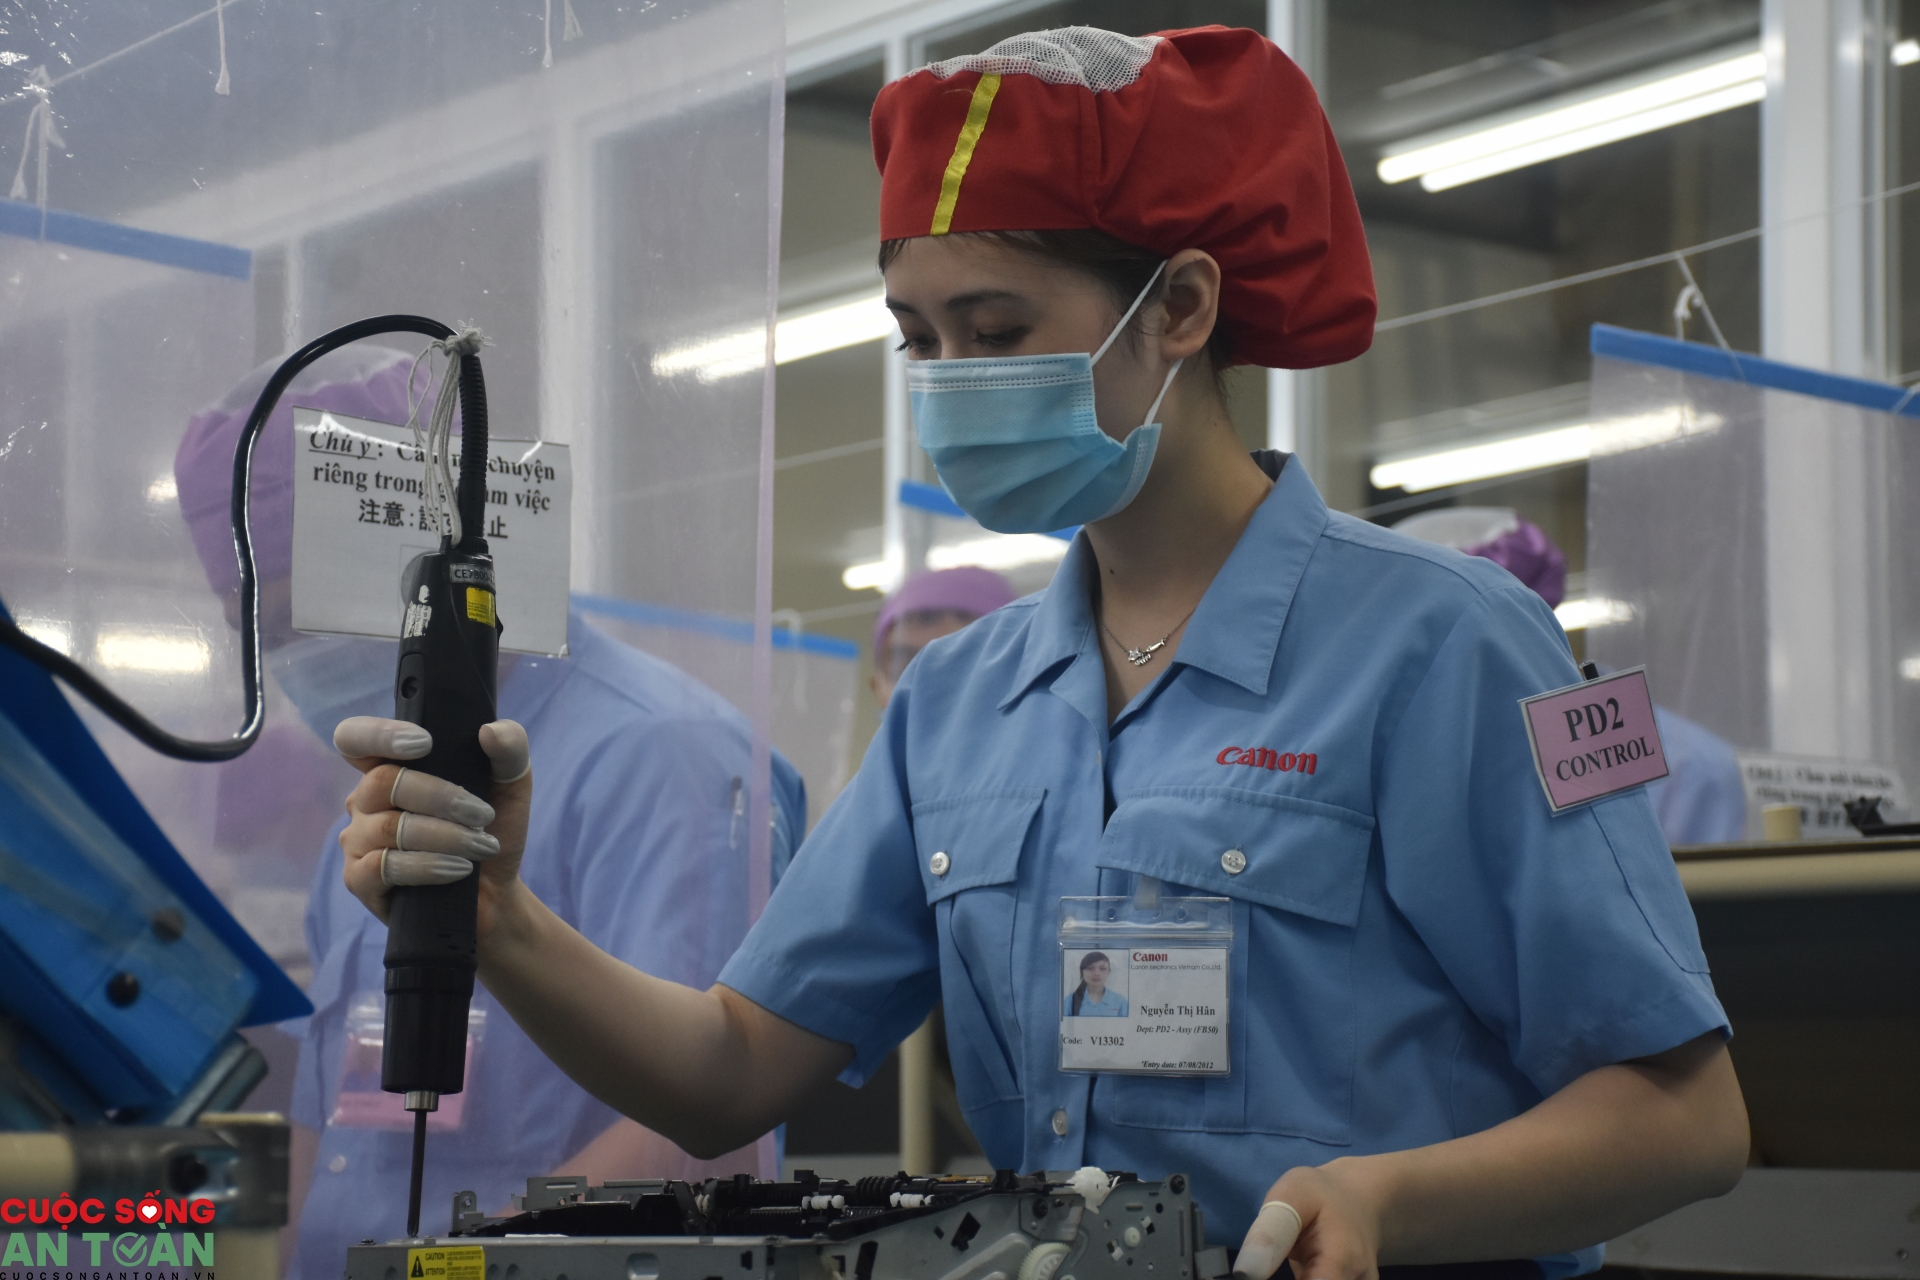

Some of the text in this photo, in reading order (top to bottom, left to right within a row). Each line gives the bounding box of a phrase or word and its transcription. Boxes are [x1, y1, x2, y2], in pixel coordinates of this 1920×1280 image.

[489, 456, 555, 484] chuyện
[313, 462, 368, 493] riêng
[515, 489, 551, 515] việc
[1562, 697, 1625, 743] PD2
[1216, 746, 1318, 776] Canon
[1555, 736, 1655, 782] CONTROL
[1132, 951, 1168, 962] Canon
[1140, 1003, 1216, 1018] Nguyễn Thị Hân
[1136, 1025, 1154, 1035] Dept:
[1155, 1025, 1170, 1033] PD2
[1176, 1025, 1192, 1035] Assy
[1193, 1025, 1218, 1035] (FB50)
[1063, 1036, 1125, 1046] Code: V13302
[1161, 1061, 1177, 1069] date:
